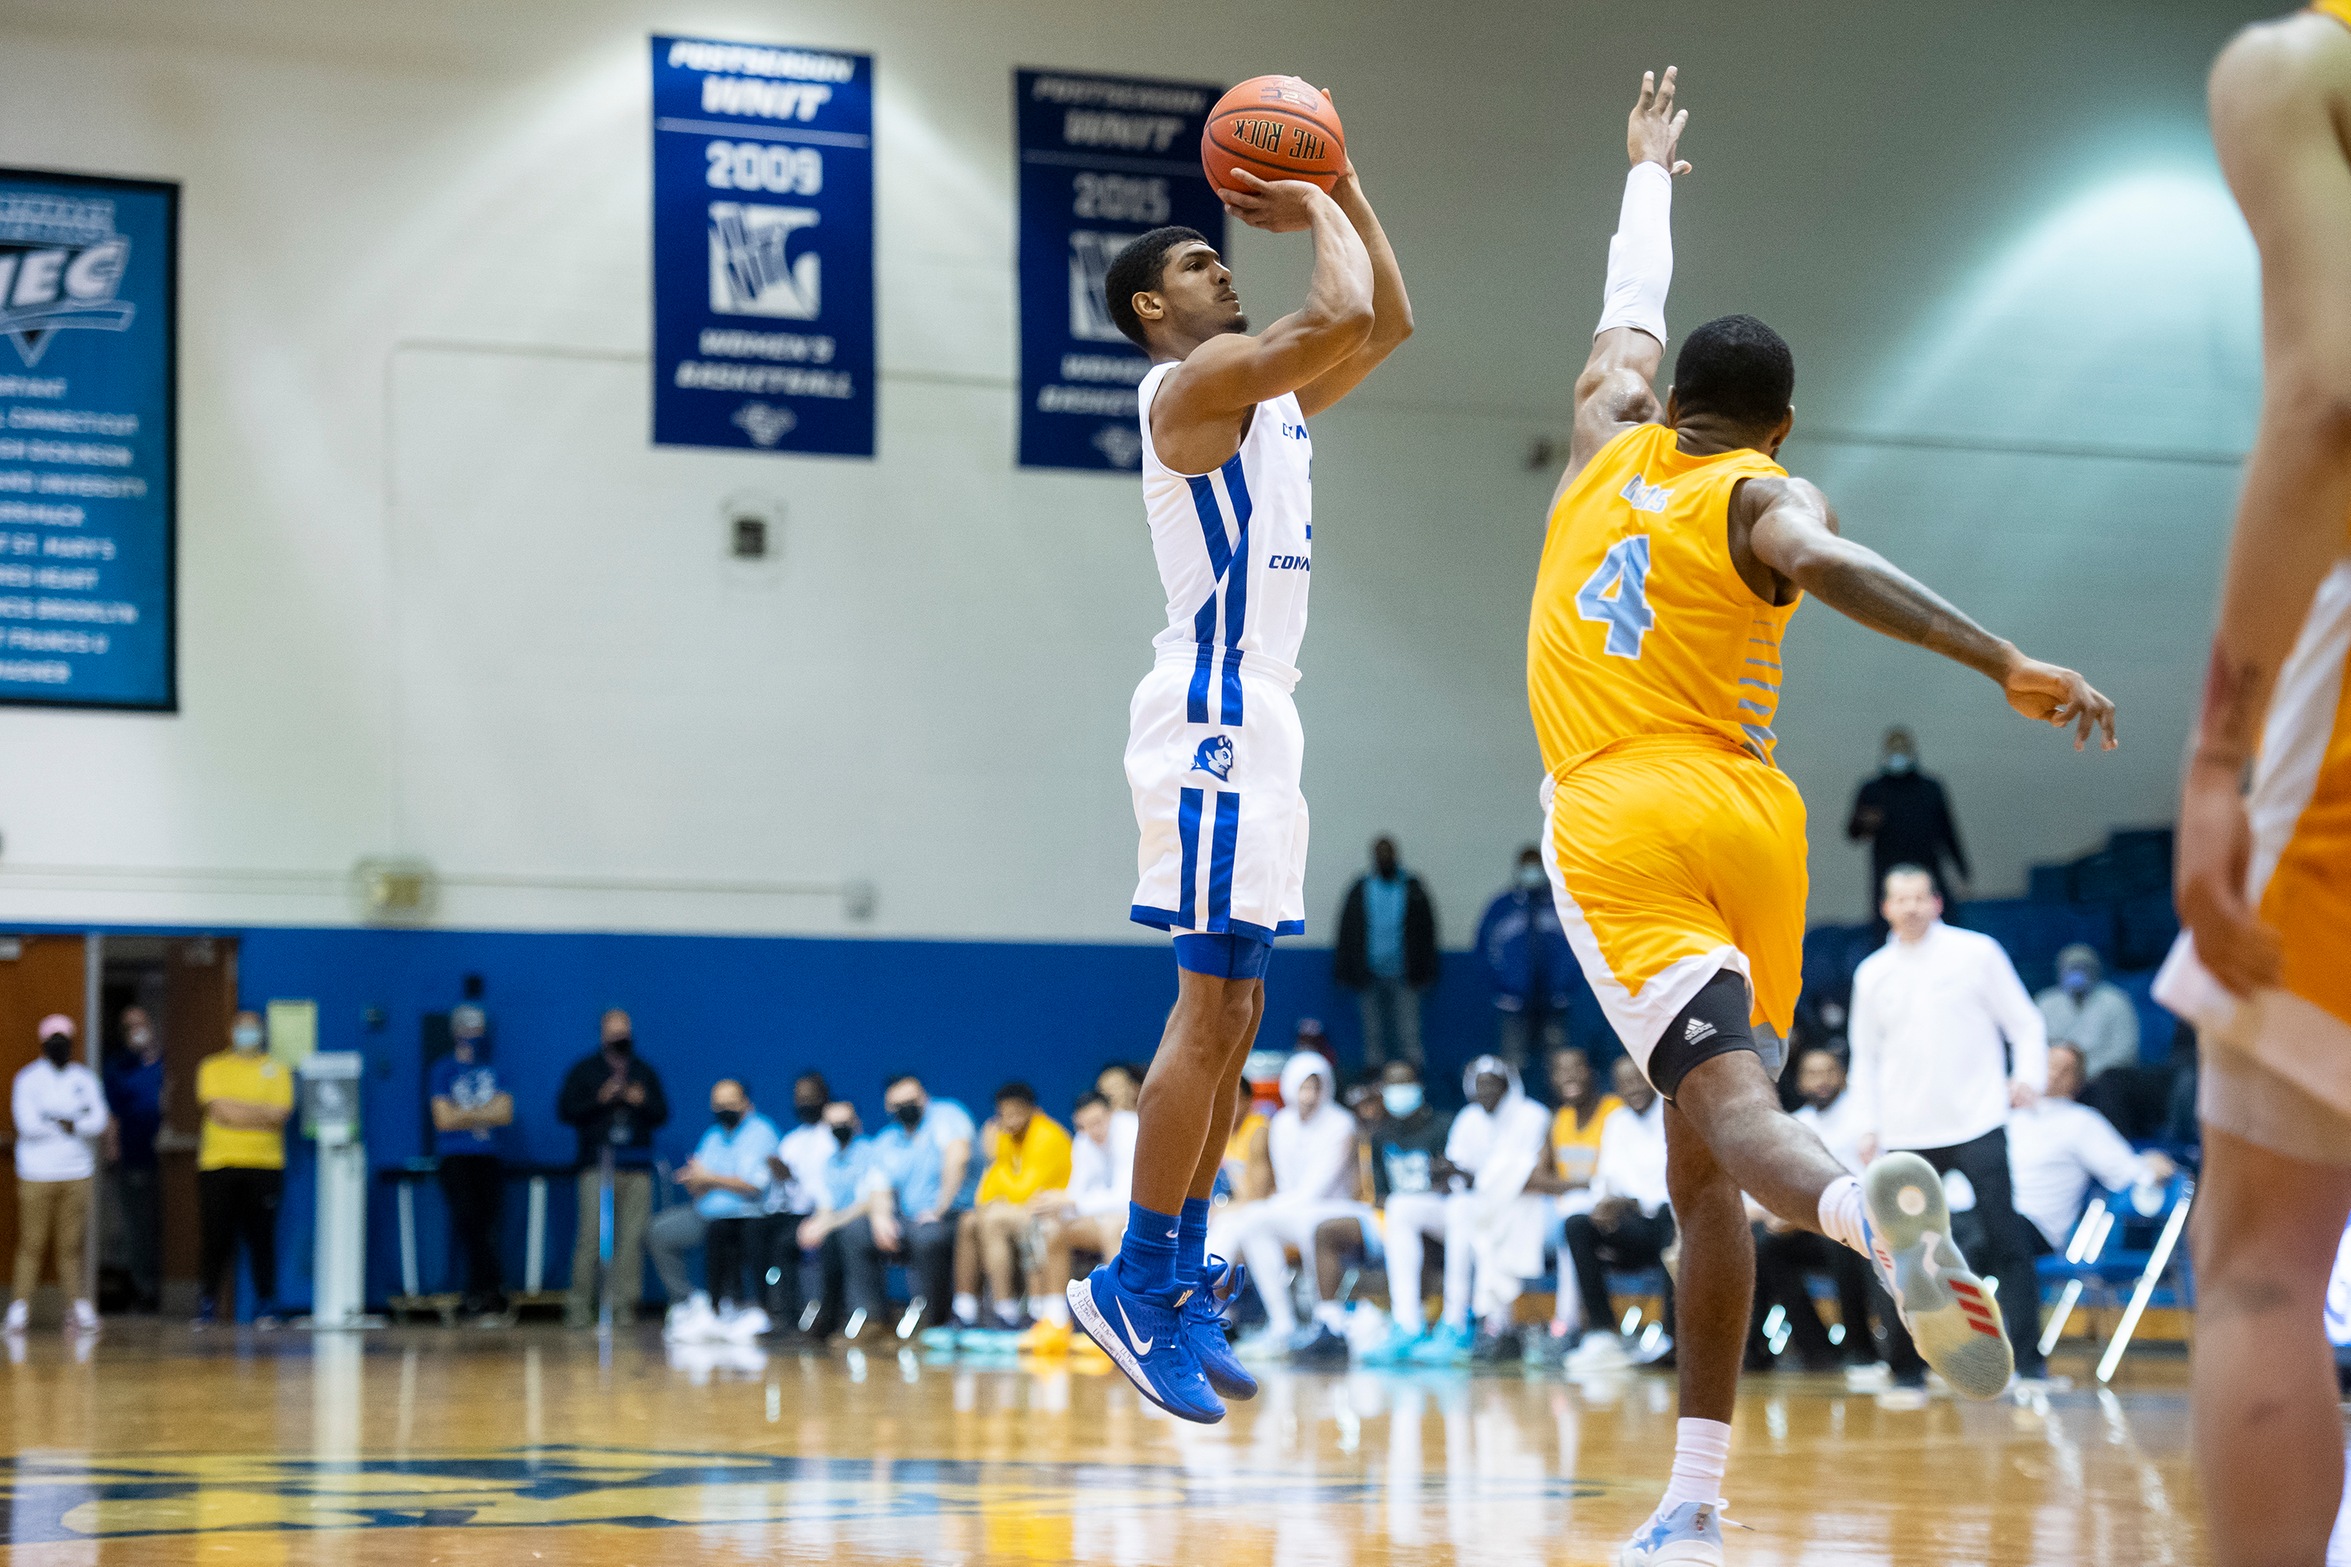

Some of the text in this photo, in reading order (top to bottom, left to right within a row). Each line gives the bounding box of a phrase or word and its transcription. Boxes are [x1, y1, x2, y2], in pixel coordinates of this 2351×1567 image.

[701, 73, 833, 122] WNIT
[1232, 118, 1326, 160] THE ROCK
[705, 139, 823, 196] 2009
[1574, 533, 1656, 661] 4
